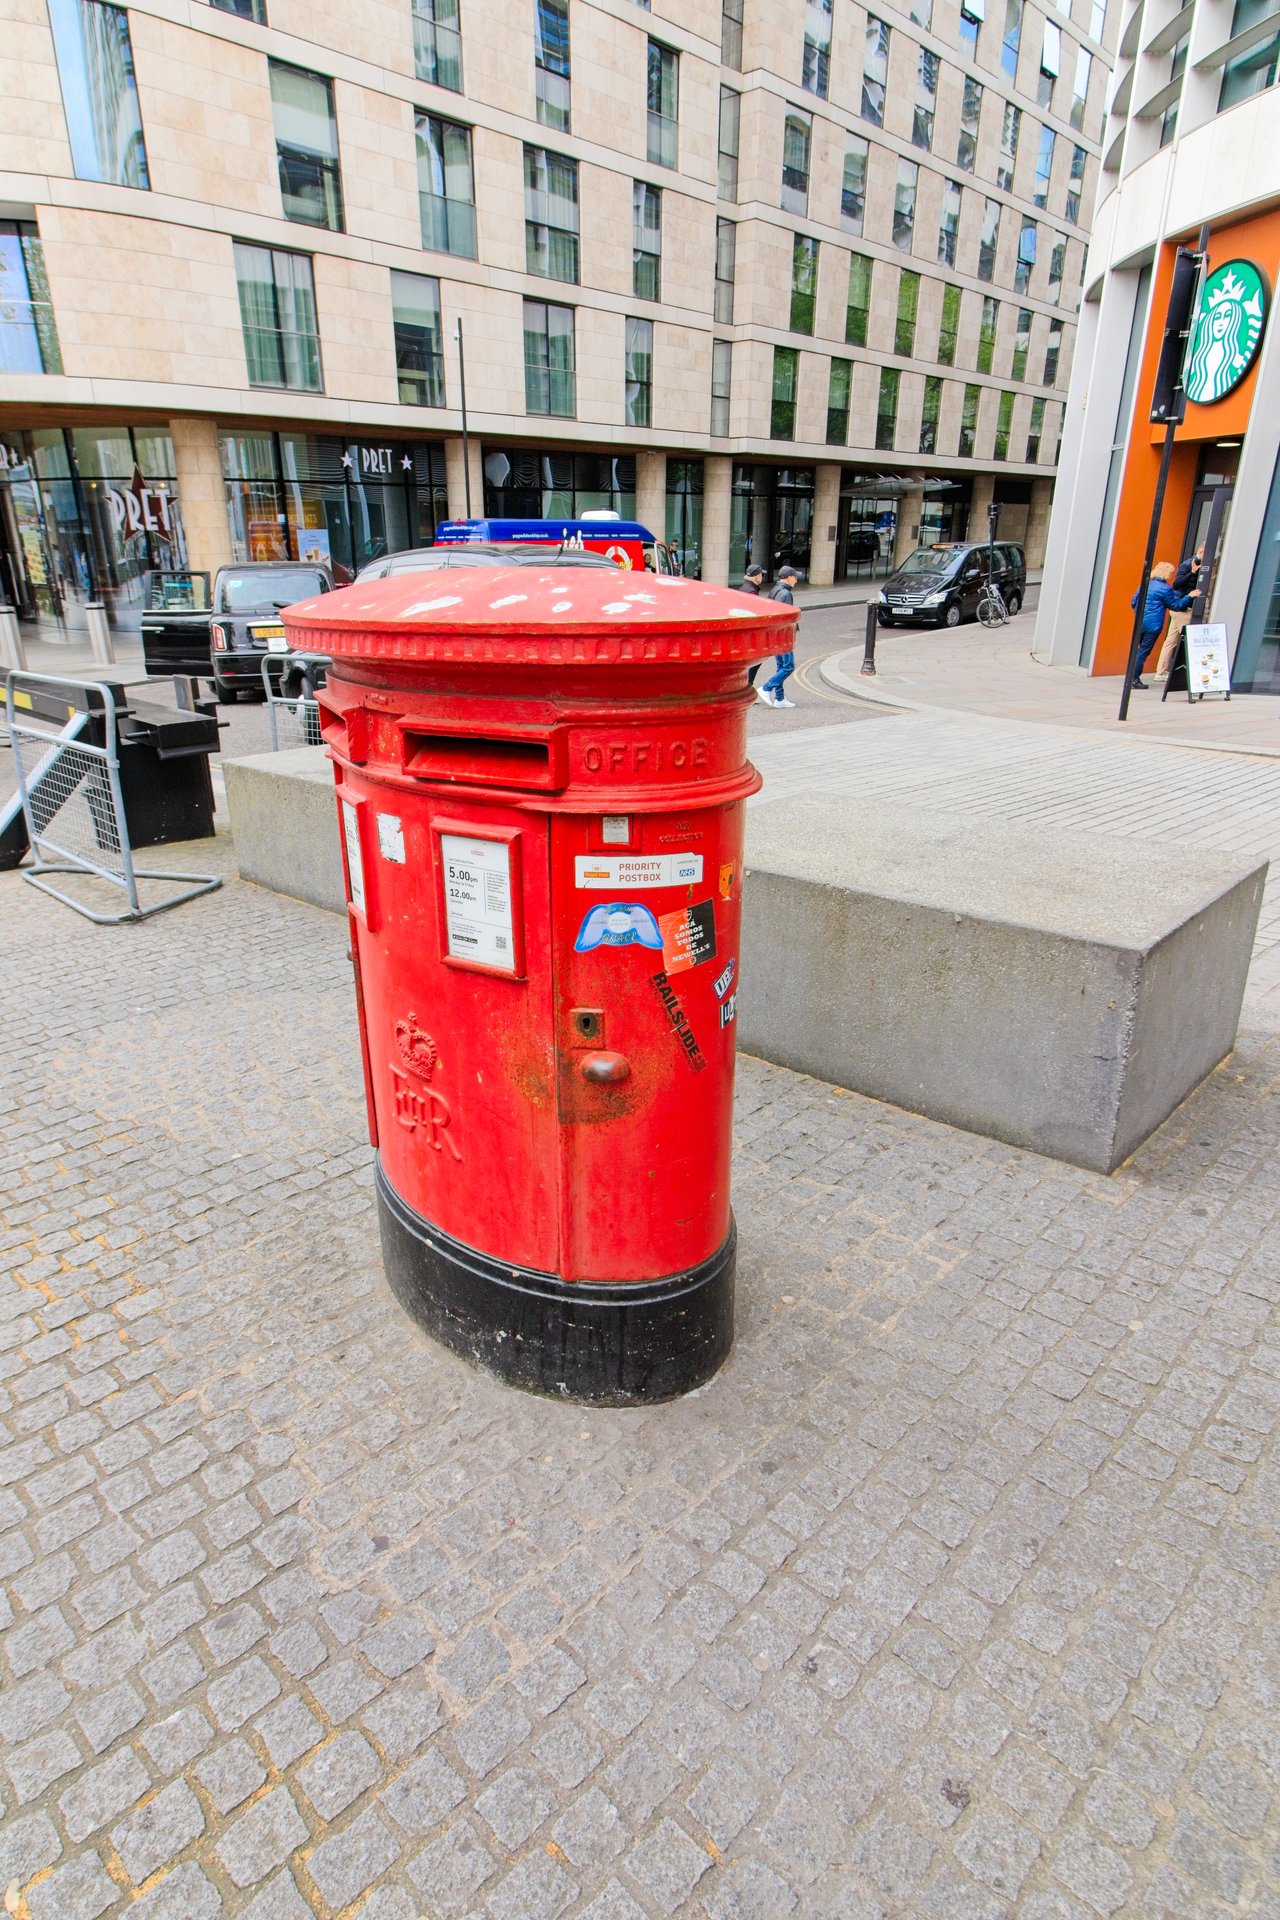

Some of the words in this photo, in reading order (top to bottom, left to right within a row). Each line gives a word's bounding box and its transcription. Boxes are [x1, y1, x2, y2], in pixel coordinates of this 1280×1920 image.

[362, 447, 393, 473] PRET
[110, 488, 172, 531] PRET
[584, 738, 708, 772] OFFICE
[619, 862, 662, 871] PRIORITY
[680, 868, 695, 877] NHS
[619, 873, 661, 882] POSTBOX
[674, 925, 703, 940] SOMOS
[677, 932, 704, 946] TODOS
[686, 942, 697, 950] DE
[652, 971, 700, 1059] RAILSLIDE
